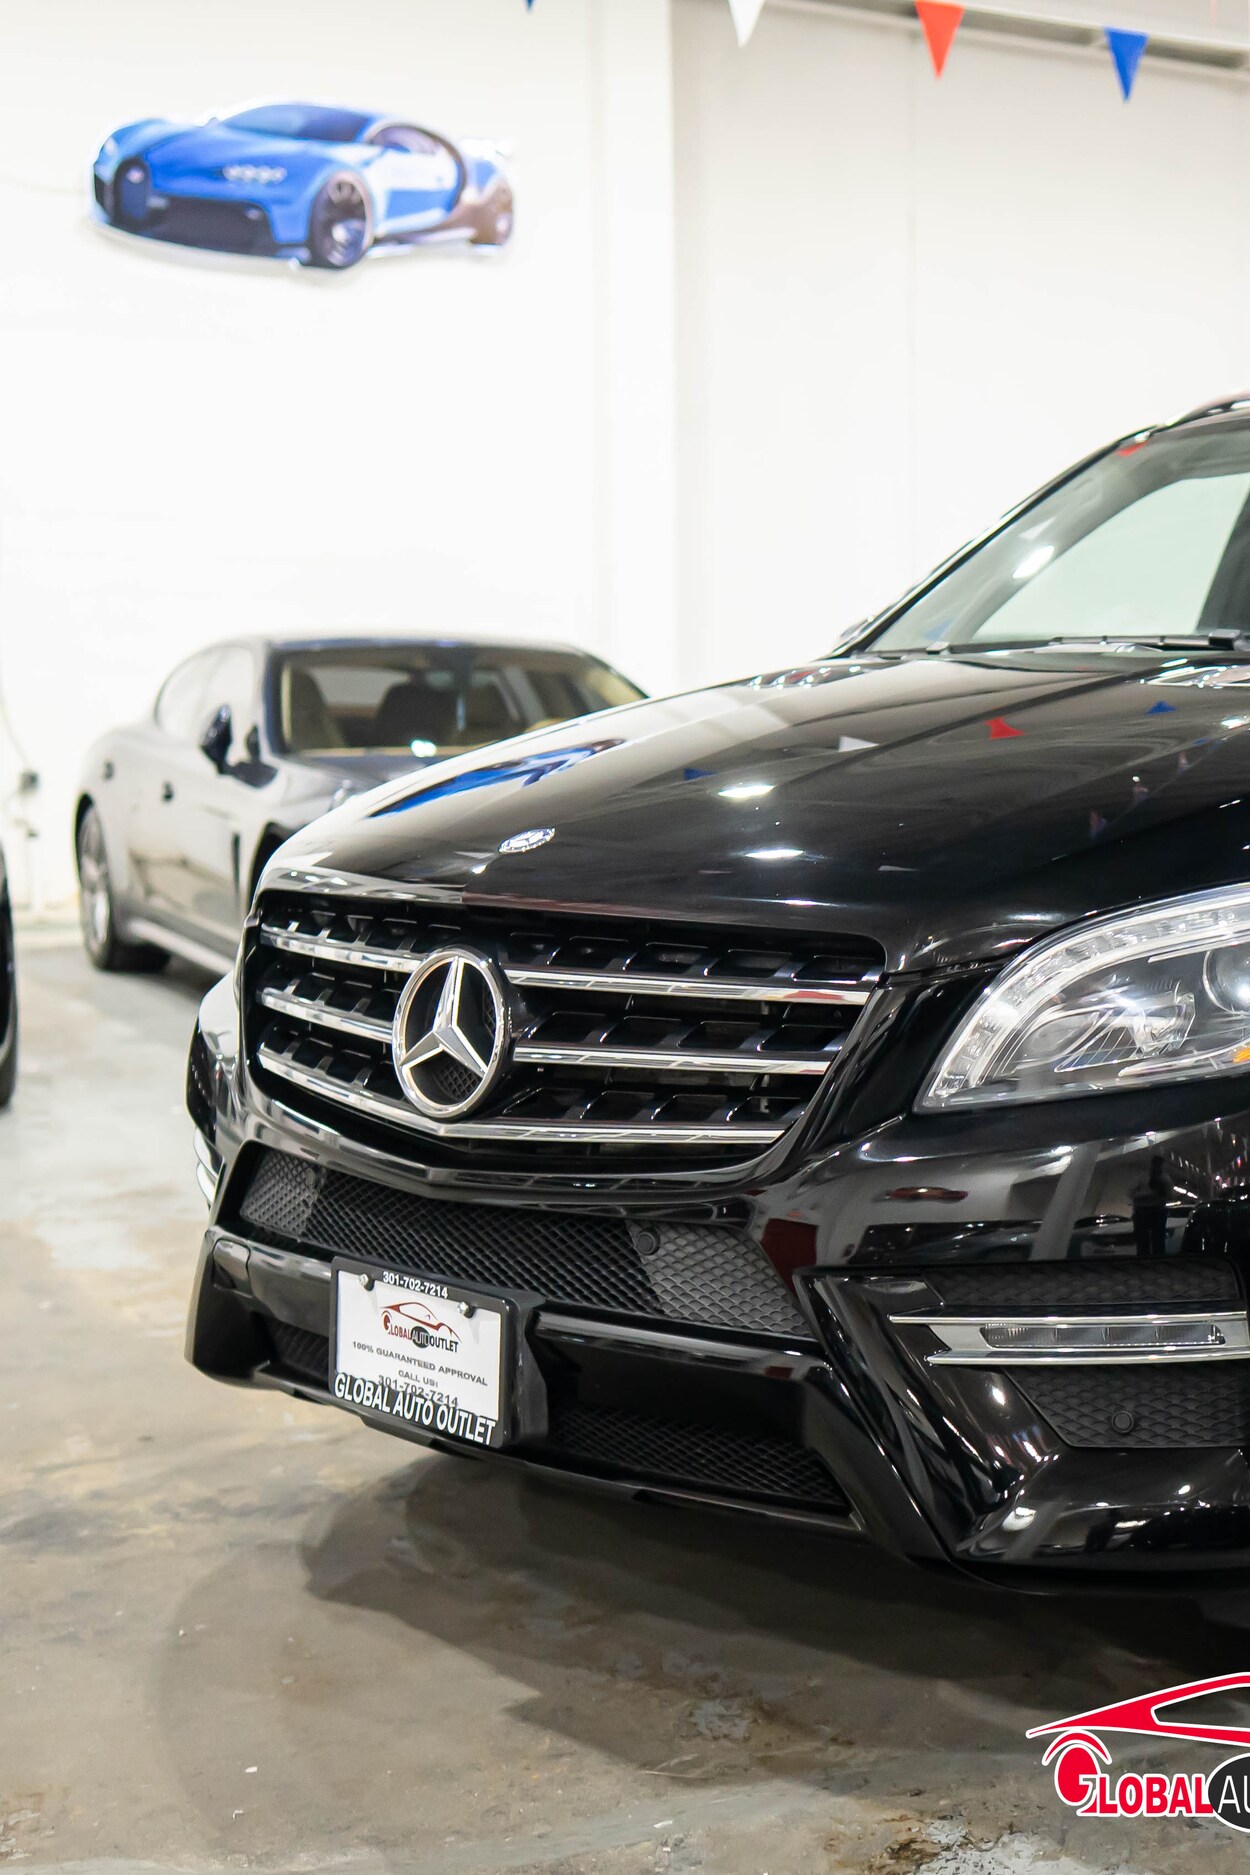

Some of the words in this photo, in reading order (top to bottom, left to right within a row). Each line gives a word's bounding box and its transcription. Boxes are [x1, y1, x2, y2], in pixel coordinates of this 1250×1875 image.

[383, 1271, 448, 1298] 301-702-7214
[353, 1341, 375, 1354] 100%
[376, 1347, 436, 1371] GUARANTEED
[438, 1365, 488, 1387] APPROVAL
[398, 1369, 421, 1384] CALL
[334, 1373, 391, 1413] GLOBAL
[392, 1391, 434, 1426] AUTO
[436, 1404, 496, 1446] OUTLET
